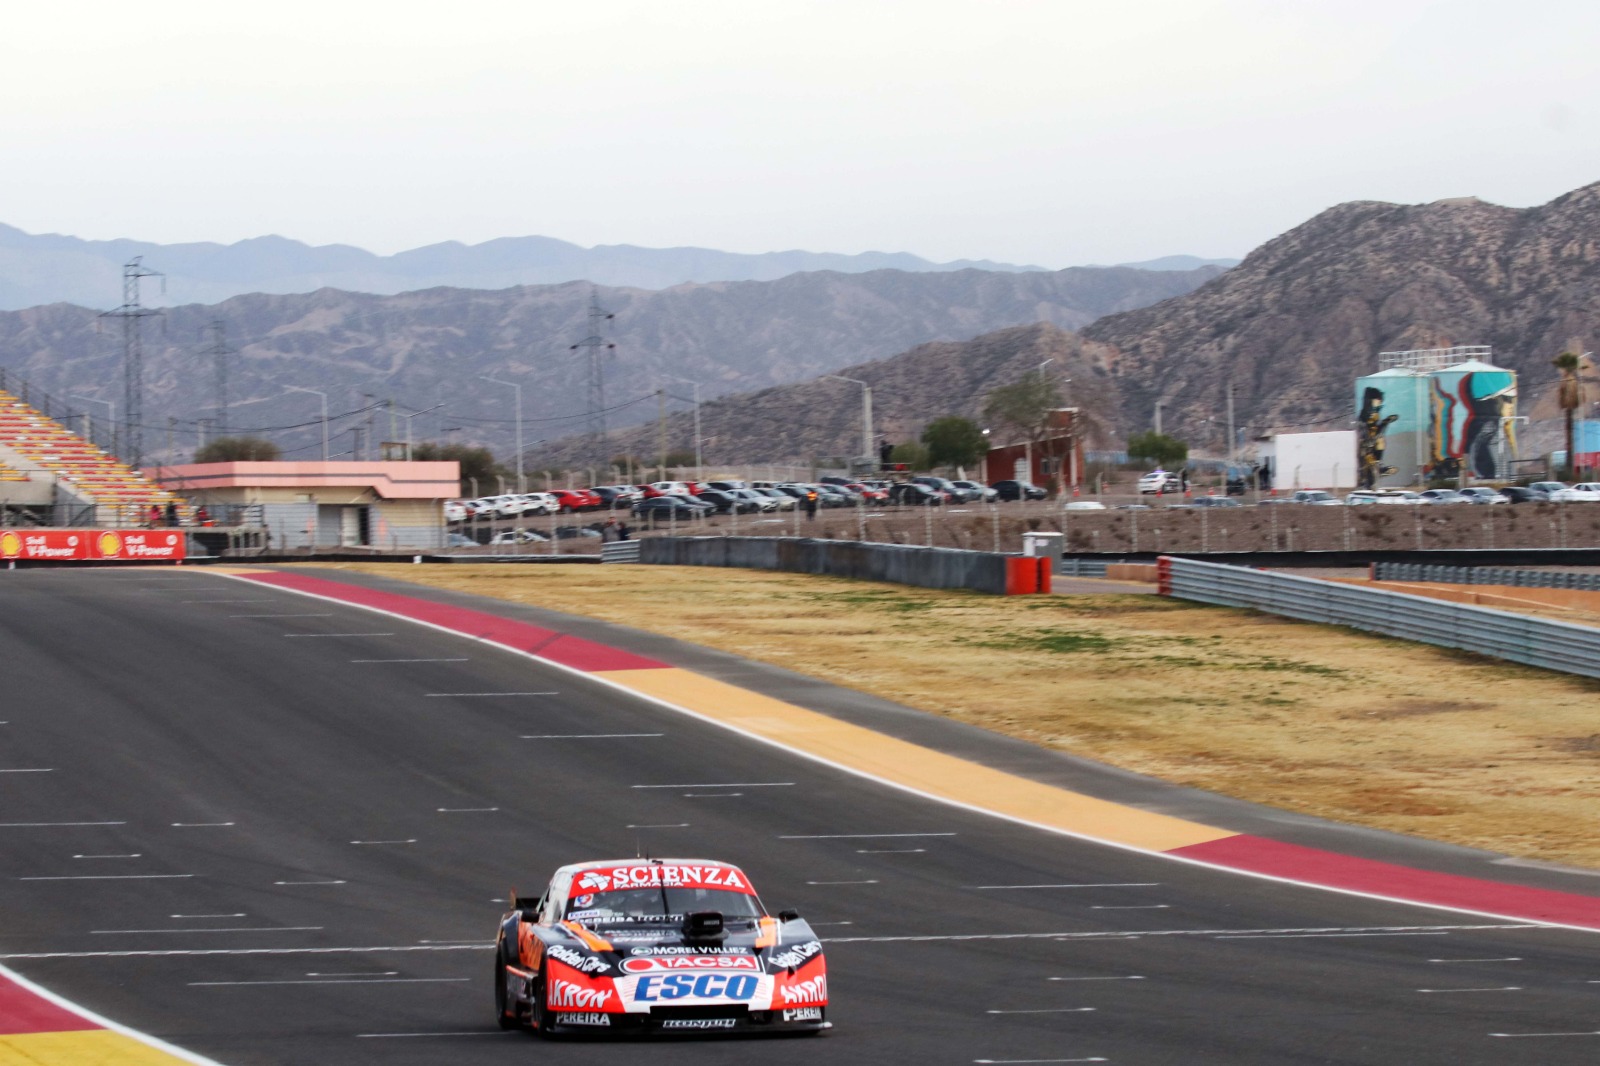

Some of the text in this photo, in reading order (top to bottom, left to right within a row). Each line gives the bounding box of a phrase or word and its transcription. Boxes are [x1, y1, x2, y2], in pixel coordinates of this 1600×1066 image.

[26, 545, 76, 557] V-Power
[125, 544, 175, 556] V-Power
[612, 866, 745, 888] SCIENZA
[653, 946, 748, 955] MOREL VULLIEZ
[547, 944, 612, 972] Golden Cars
[661, 957, 754, 968] TACSA
[633, 974, 759, 1001] ESCO
[556, 1012, 611, 1026] PEREIRA
